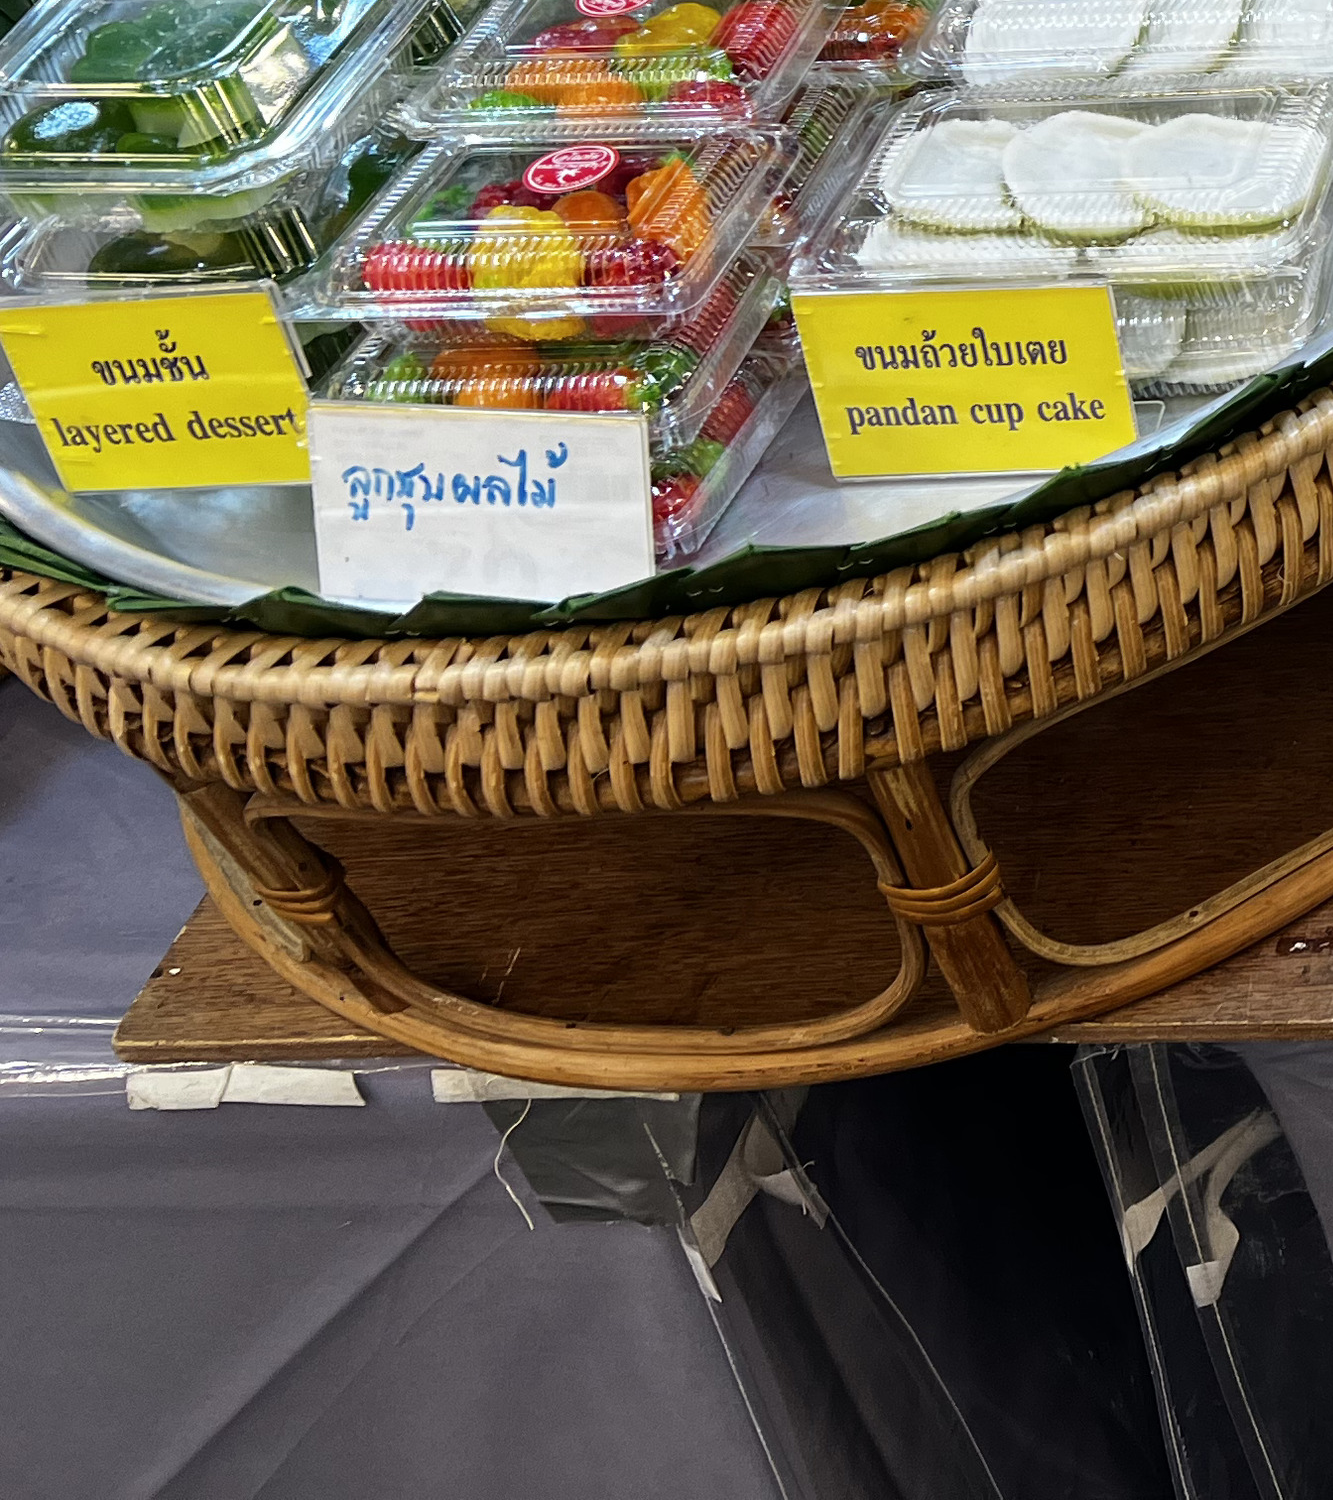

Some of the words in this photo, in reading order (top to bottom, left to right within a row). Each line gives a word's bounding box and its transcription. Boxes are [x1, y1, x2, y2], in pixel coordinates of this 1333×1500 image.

[91, 329, 210, 386] ขนมชั้น
[855, 327, 1068, 370] ขนมถ้วยใบเตย
[50, 413, 176, 453] layered
[187, 407, 305, 440] dessert
[845, 397, 959, 435] pandan
[970, 401, 1024, 431] cup
[1037, 392, 1106, 422] cake
